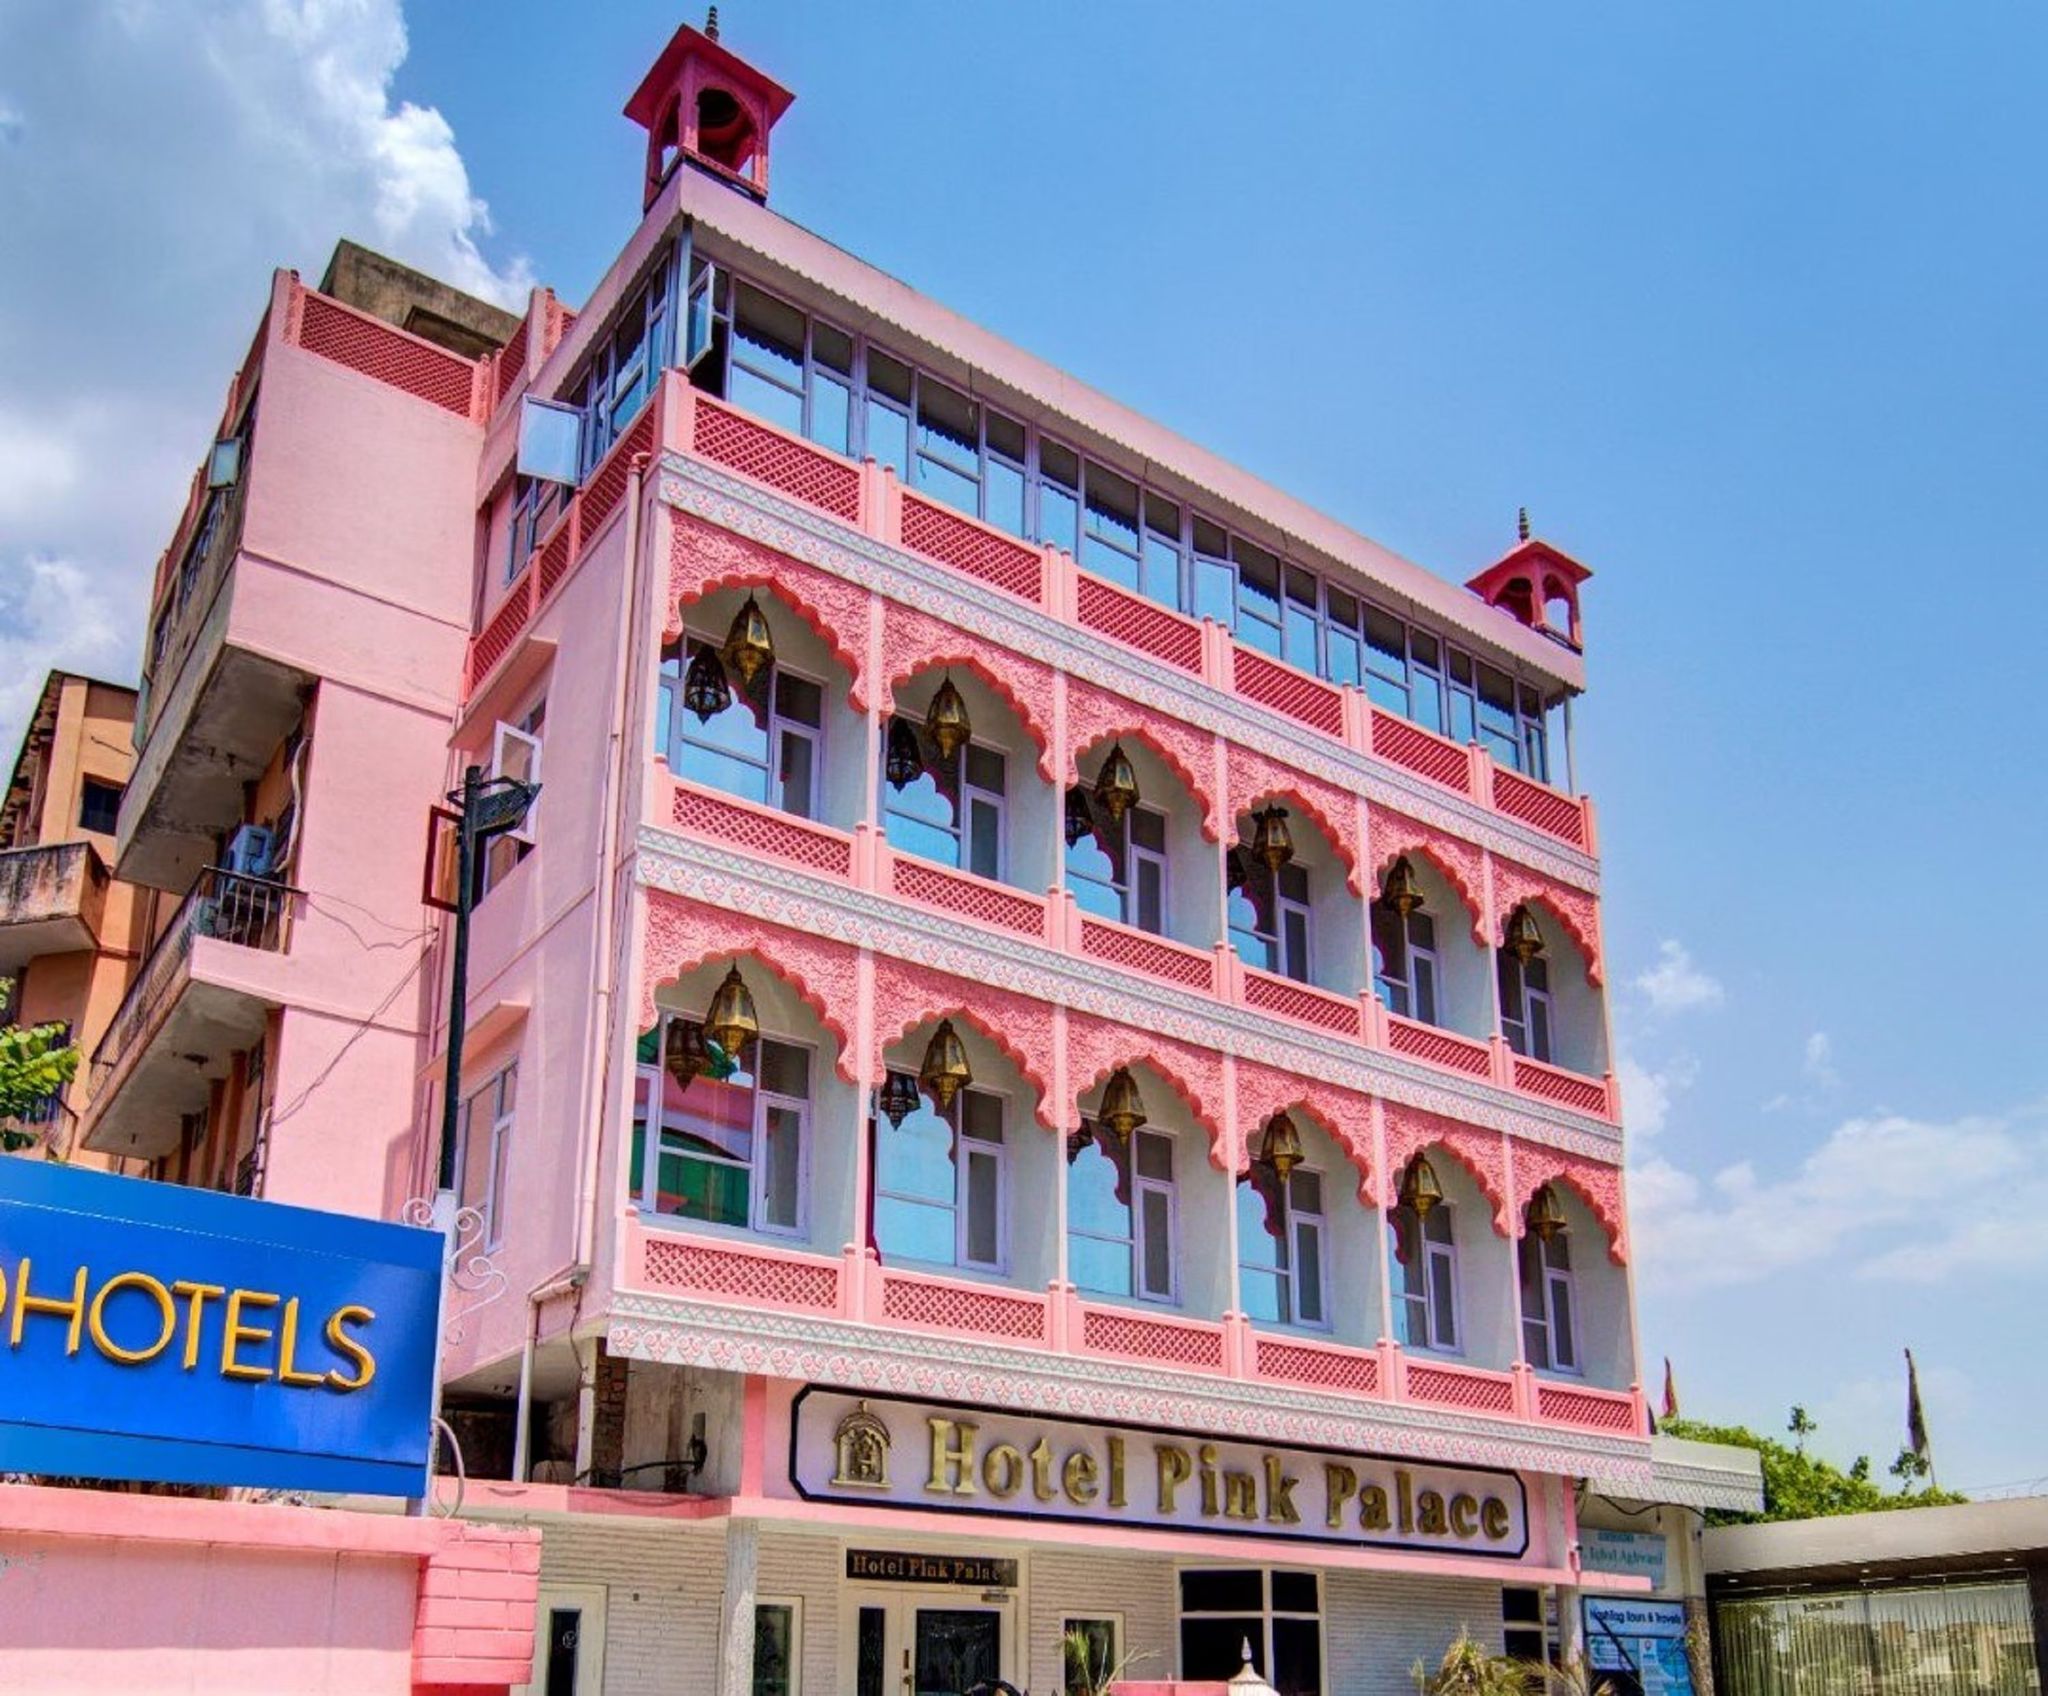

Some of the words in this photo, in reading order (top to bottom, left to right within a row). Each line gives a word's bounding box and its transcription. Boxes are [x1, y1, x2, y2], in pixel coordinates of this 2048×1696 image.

[0, 1258, 376, 1392] HOTELS
[926, 1417, 1128, 1507] Hotel
[1154, 1444, 1301, 1524] Pink
[1324, 1462, 1510, 1540] Palace
[853, 1555, 904, 1577] Hotel
